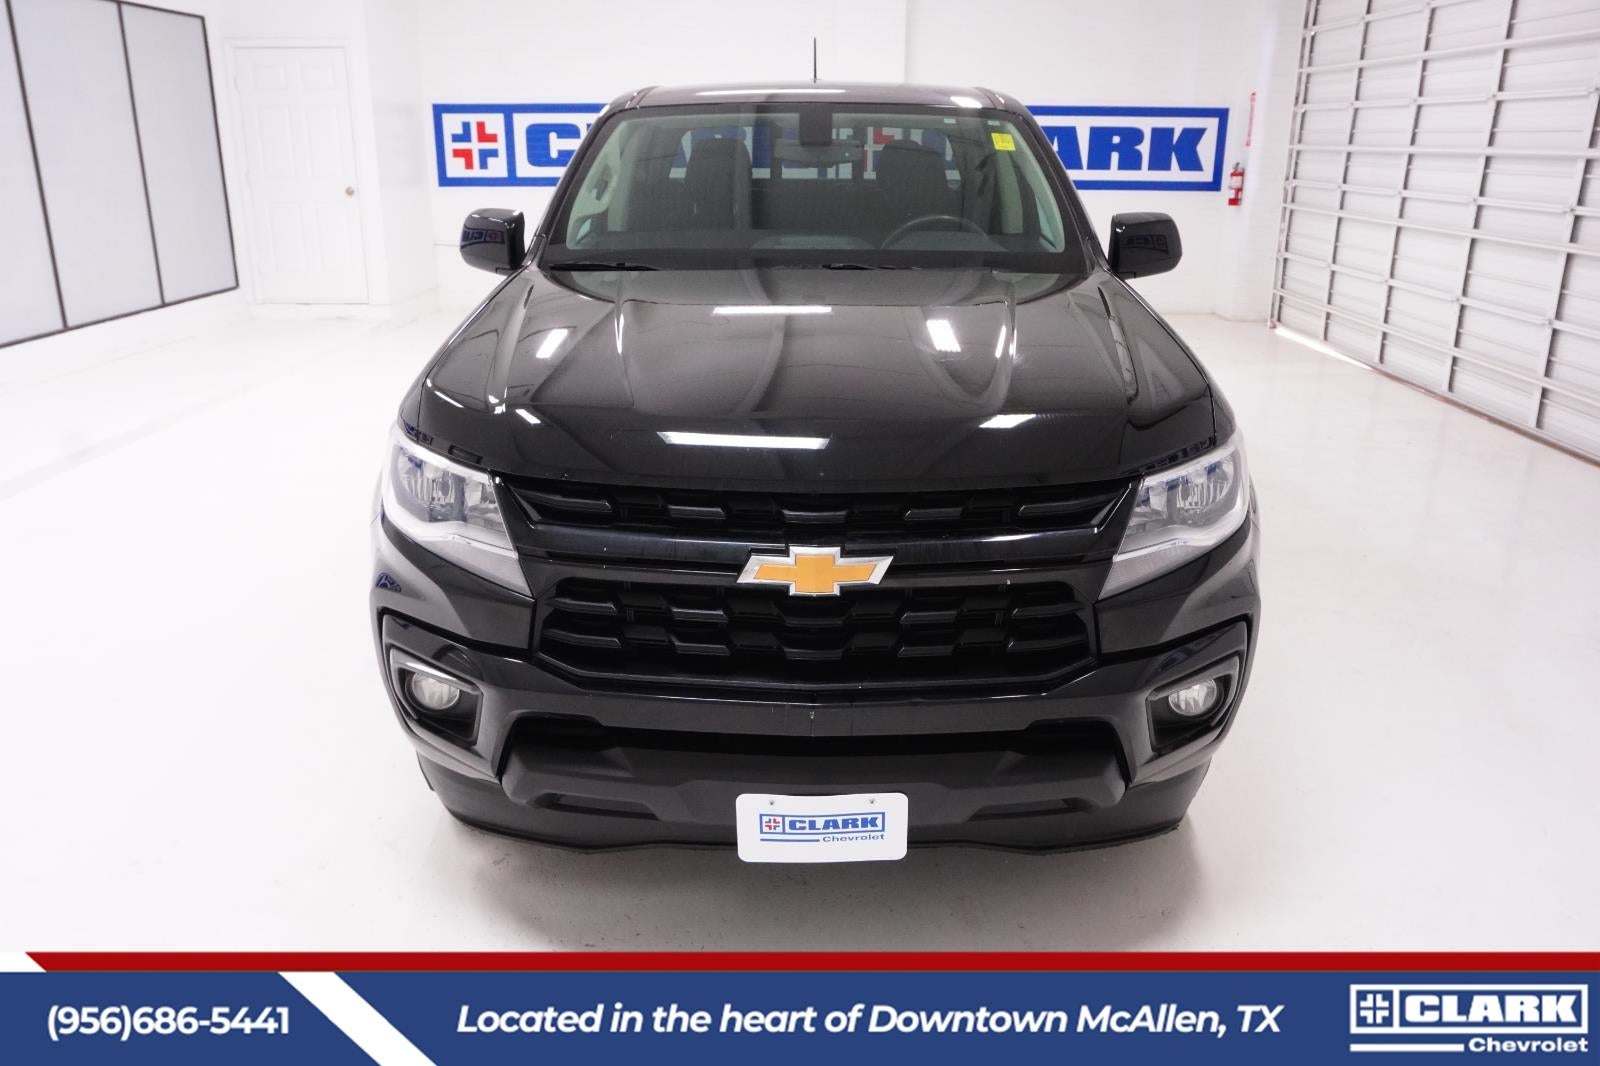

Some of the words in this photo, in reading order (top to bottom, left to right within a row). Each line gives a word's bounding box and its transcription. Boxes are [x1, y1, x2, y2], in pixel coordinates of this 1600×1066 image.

[1041, 126, 1207, 171] ARK
[788, 816, 879, 831] CLARK
[822, 833, 886, 843] Chevrolet
